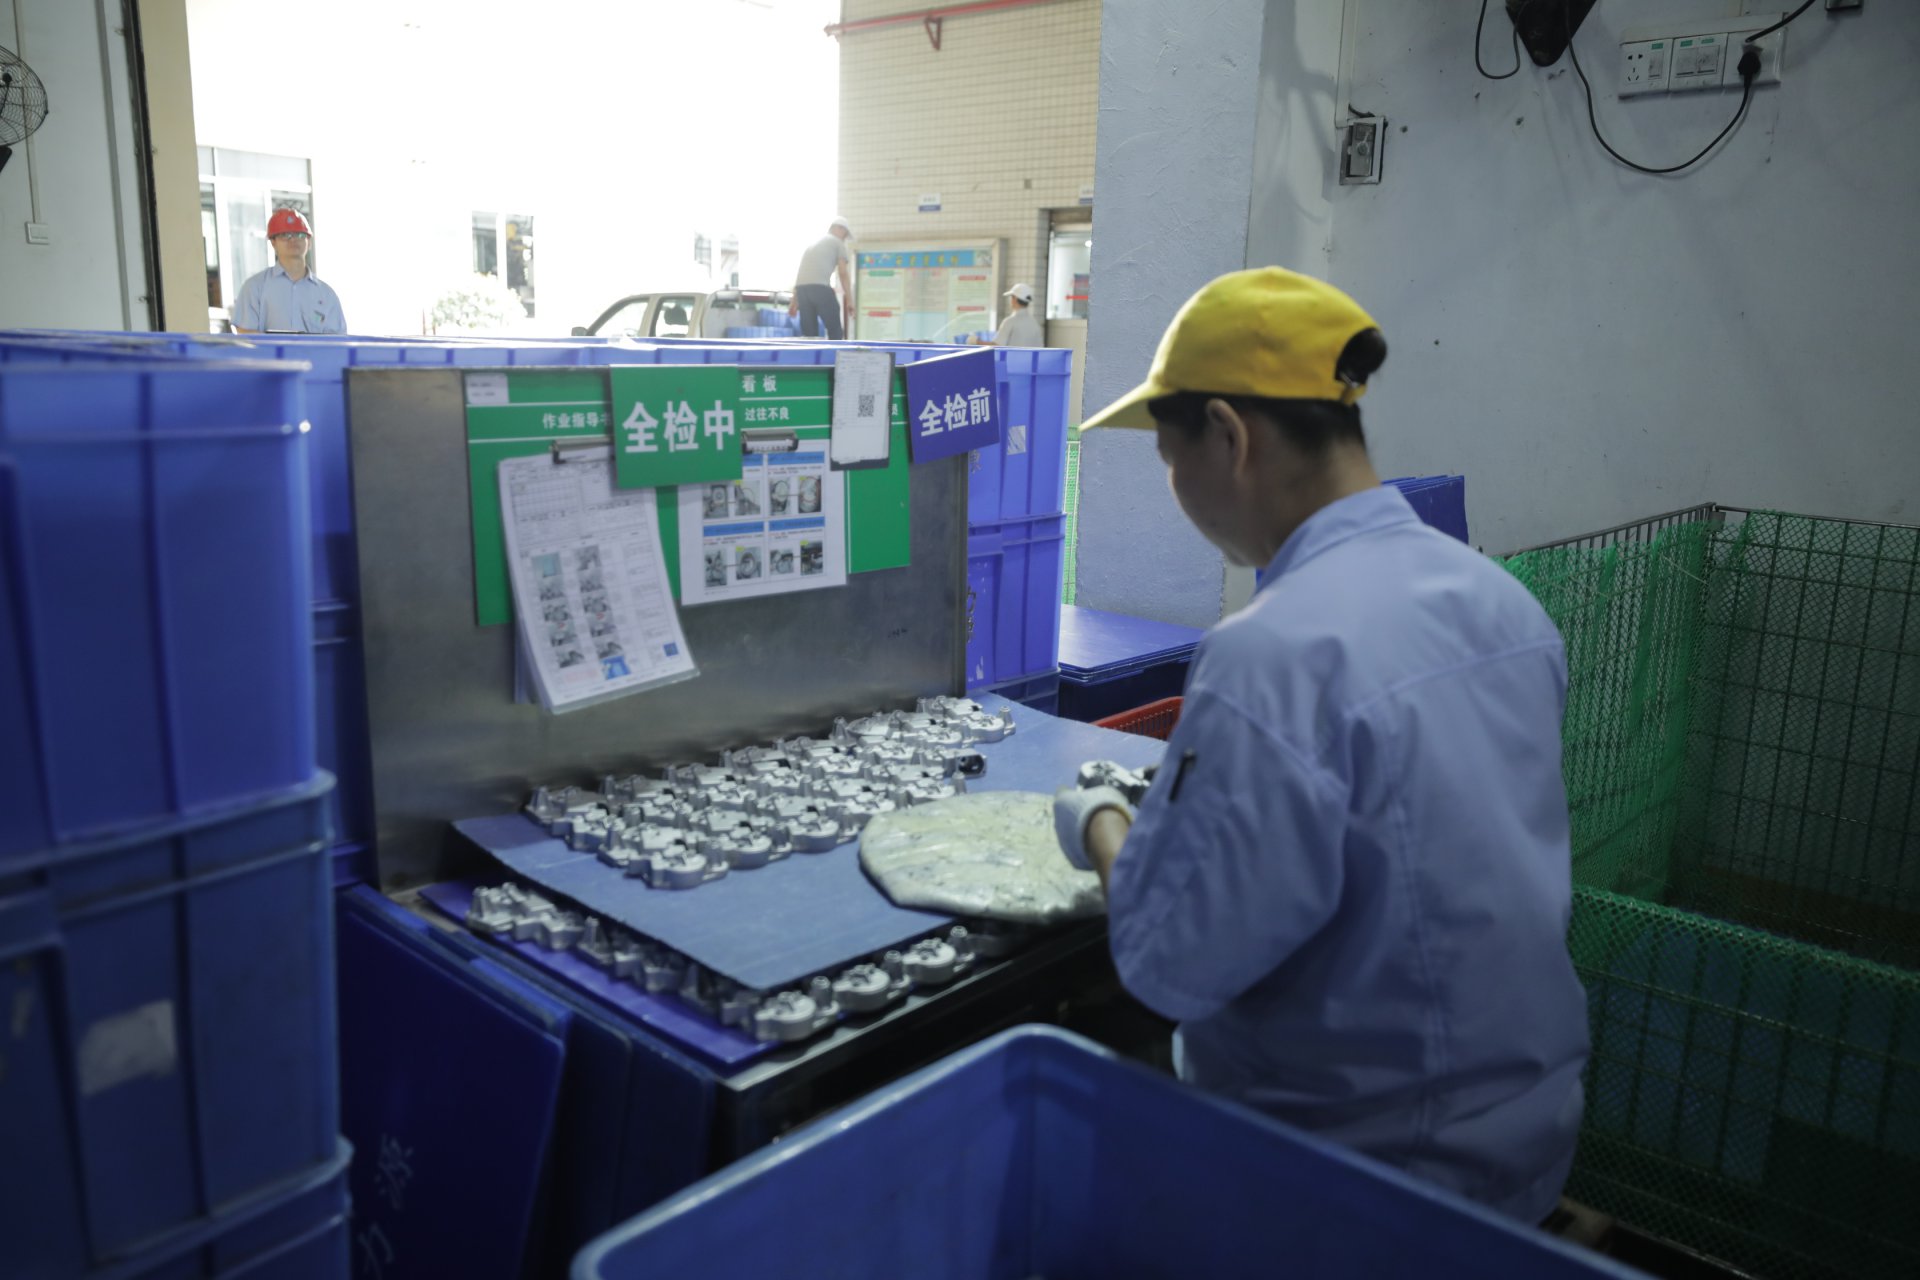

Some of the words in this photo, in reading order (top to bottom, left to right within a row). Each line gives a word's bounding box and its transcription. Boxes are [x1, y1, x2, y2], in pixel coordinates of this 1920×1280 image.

[622, 400, 735, 453] 全检中
[744, 406, 790, 421] 过往不良
[918, 387, 992, 438] 全检前
